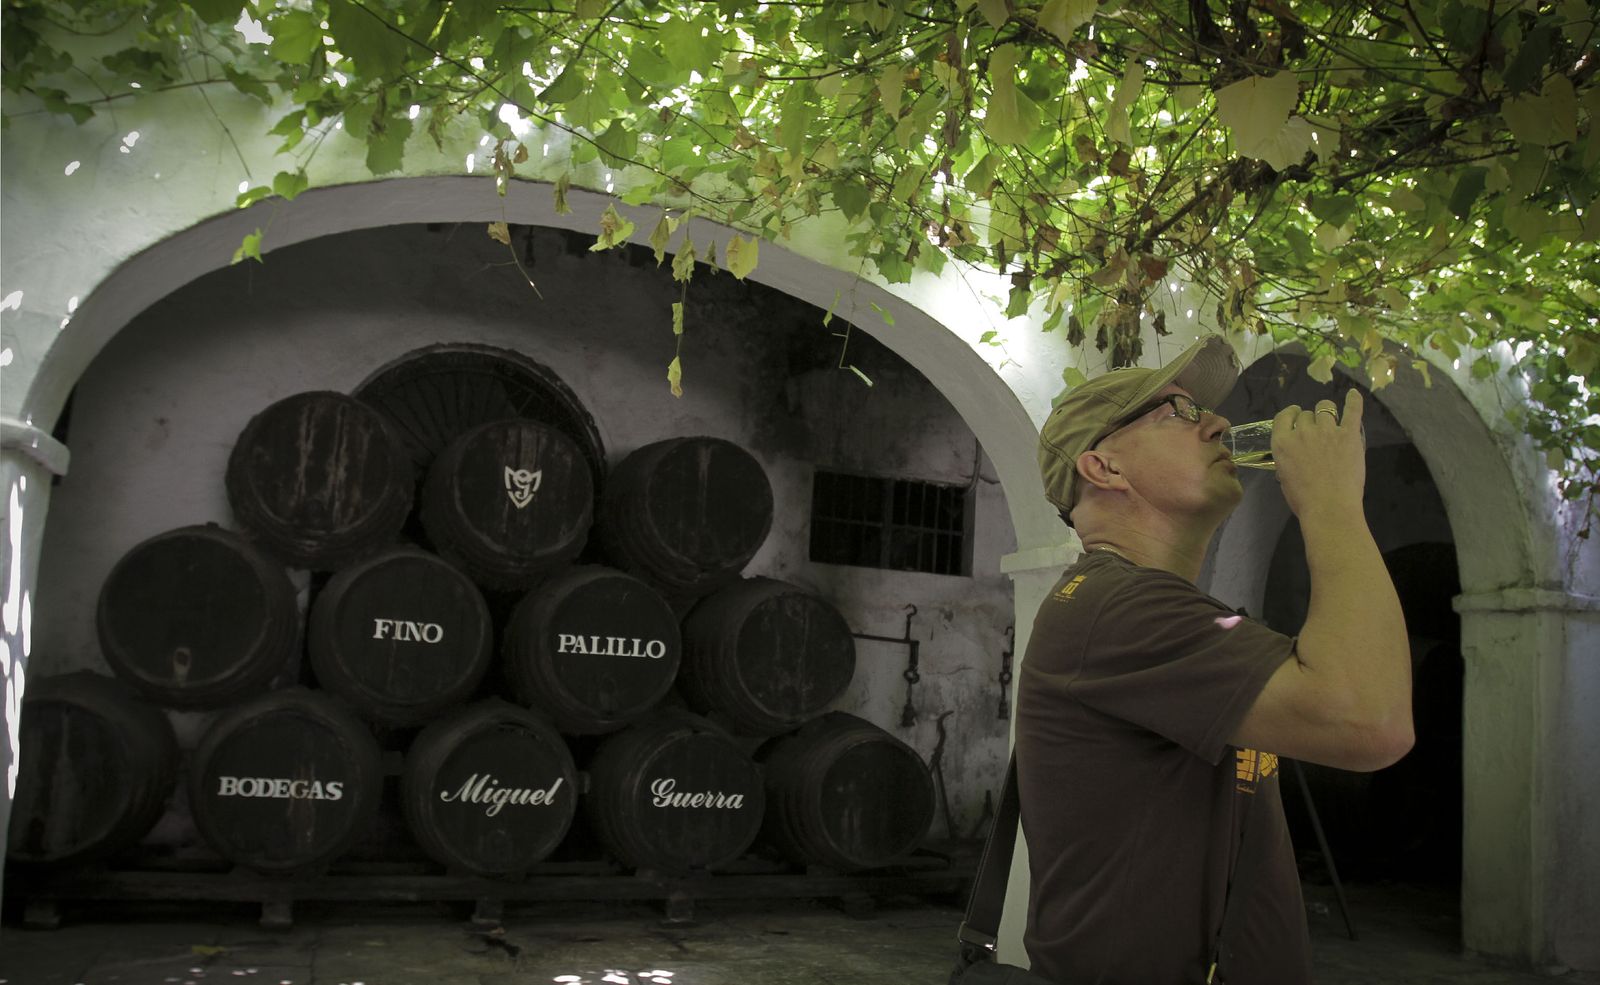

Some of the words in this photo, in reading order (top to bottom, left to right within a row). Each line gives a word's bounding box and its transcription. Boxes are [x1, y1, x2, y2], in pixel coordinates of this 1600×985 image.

[373, 618, 444, 644] FINO
[558, 633, 667, 659] PALILLO
[218, 776, 344, 801] BODEGAS
[440, 774, 564, 817] Miguel
[650, 779, 744, 809] Guerra
